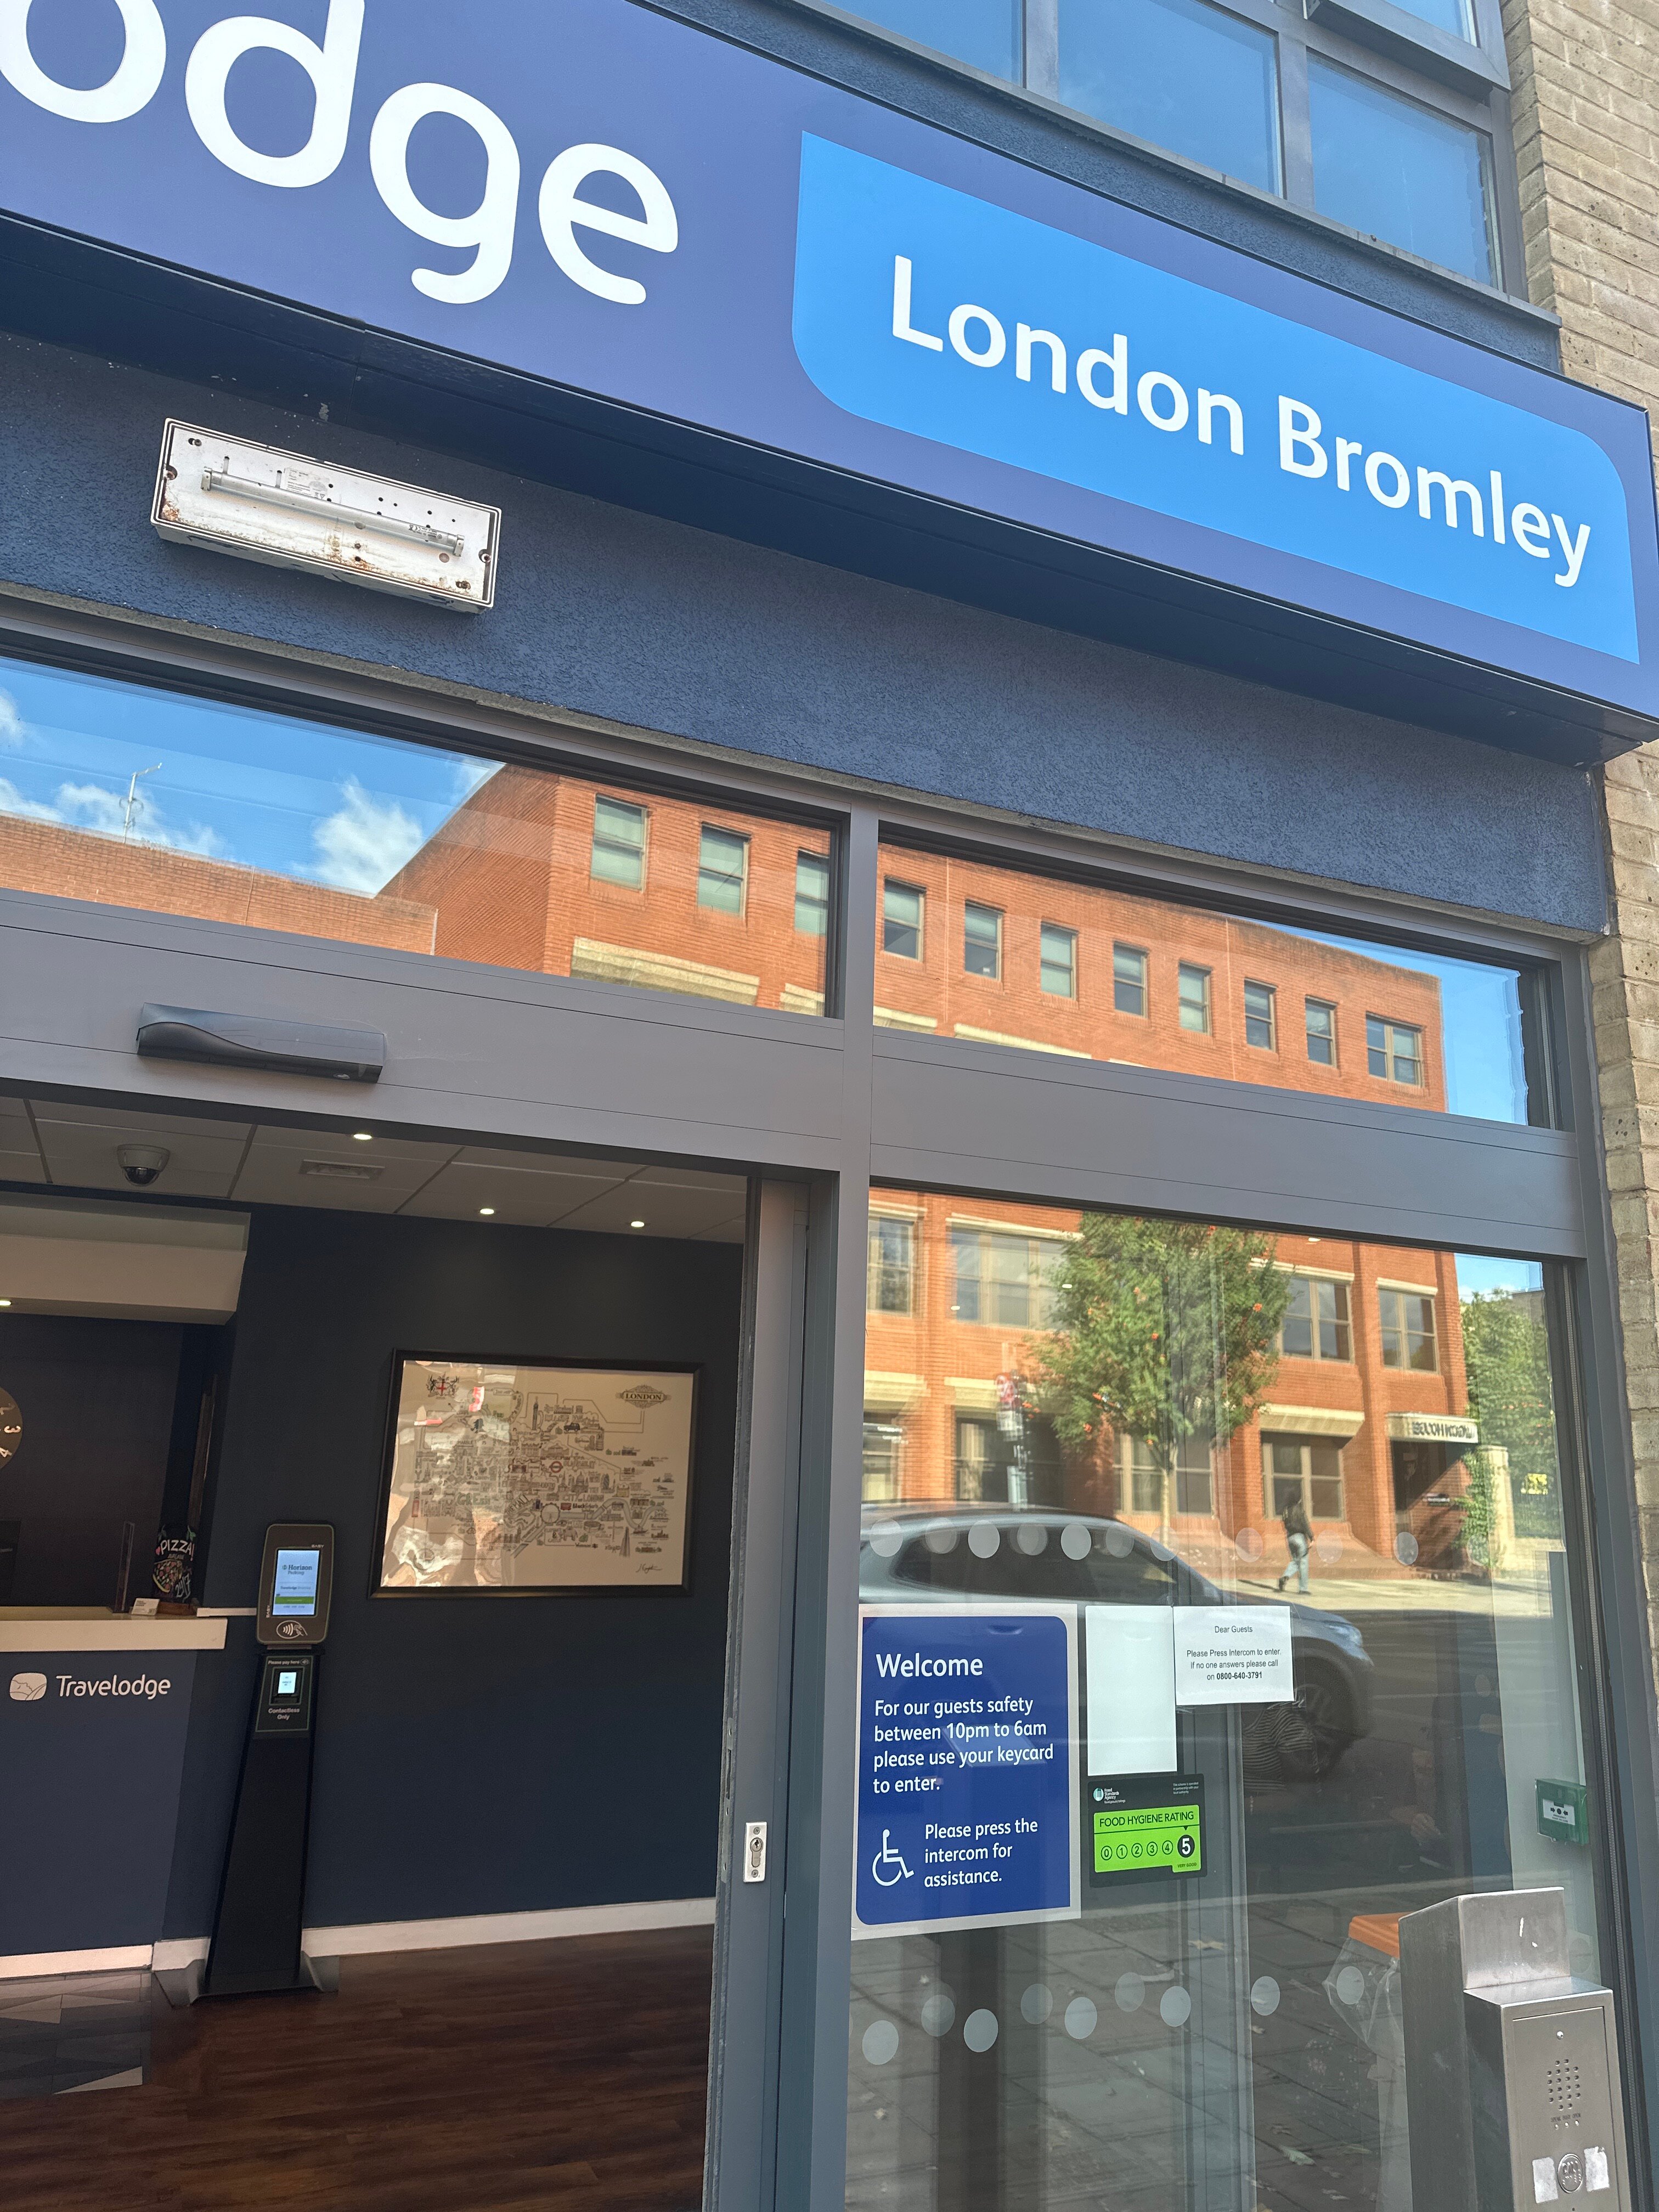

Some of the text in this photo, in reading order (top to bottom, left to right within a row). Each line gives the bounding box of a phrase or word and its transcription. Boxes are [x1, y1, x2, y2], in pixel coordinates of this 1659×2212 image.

[891, 255, 1592, 588] London Bromley
[876, 1653, 984, 1678] Welcome
[1246, 1660, 1266, 1668] please
[56, 1674, 171, 1700] Travelodge
[874, 1696, 1034, 1718] For our guests safety
[874, 1720, 1047, 1742] between 10pm to 6am
[873, 1743, 1054, 1772] please use your keycard
[873, 1776, 941, 1793] to enter.
[924, 1818, 1038, 1840] Please press the
[1100, 1811, 1194, 1827] FOOD HYGIENE RATING
[924, 1843, 1013, 1864] intercom for
[1104, 1849, 1109, 1857] 0
[1165, 1843, 1170, 1852] 4
[1182, 1838, 1190, 1854] 5
[924, 1870, 1003, 1887] assistance.
